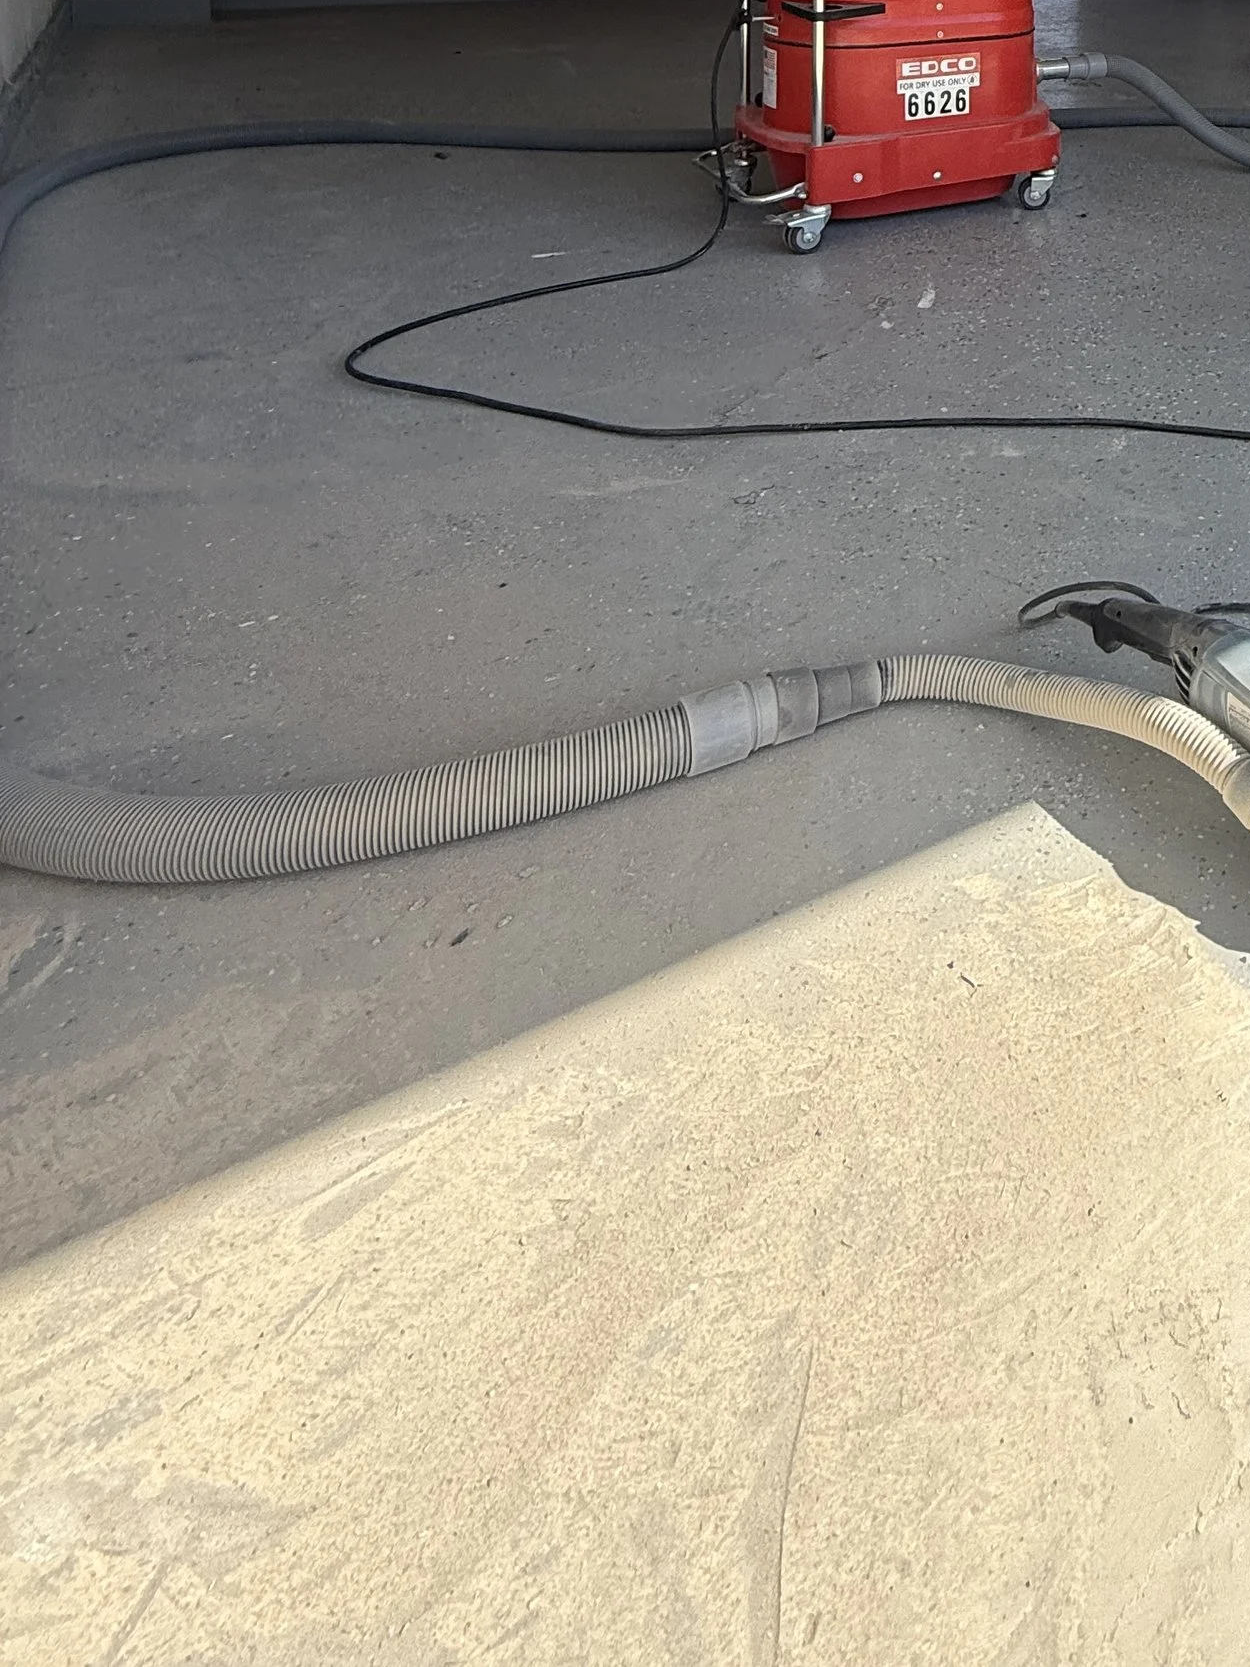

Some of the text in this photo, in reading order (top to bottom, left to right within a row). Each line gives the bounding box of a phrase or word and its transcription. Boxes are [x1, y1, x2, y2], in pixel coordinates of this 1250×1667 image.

[902, 57, 976, 77] EDCO
[899, 77, 967, 91] FOR DRY USE ONLY
[908, 89, 967, 117] 6626
